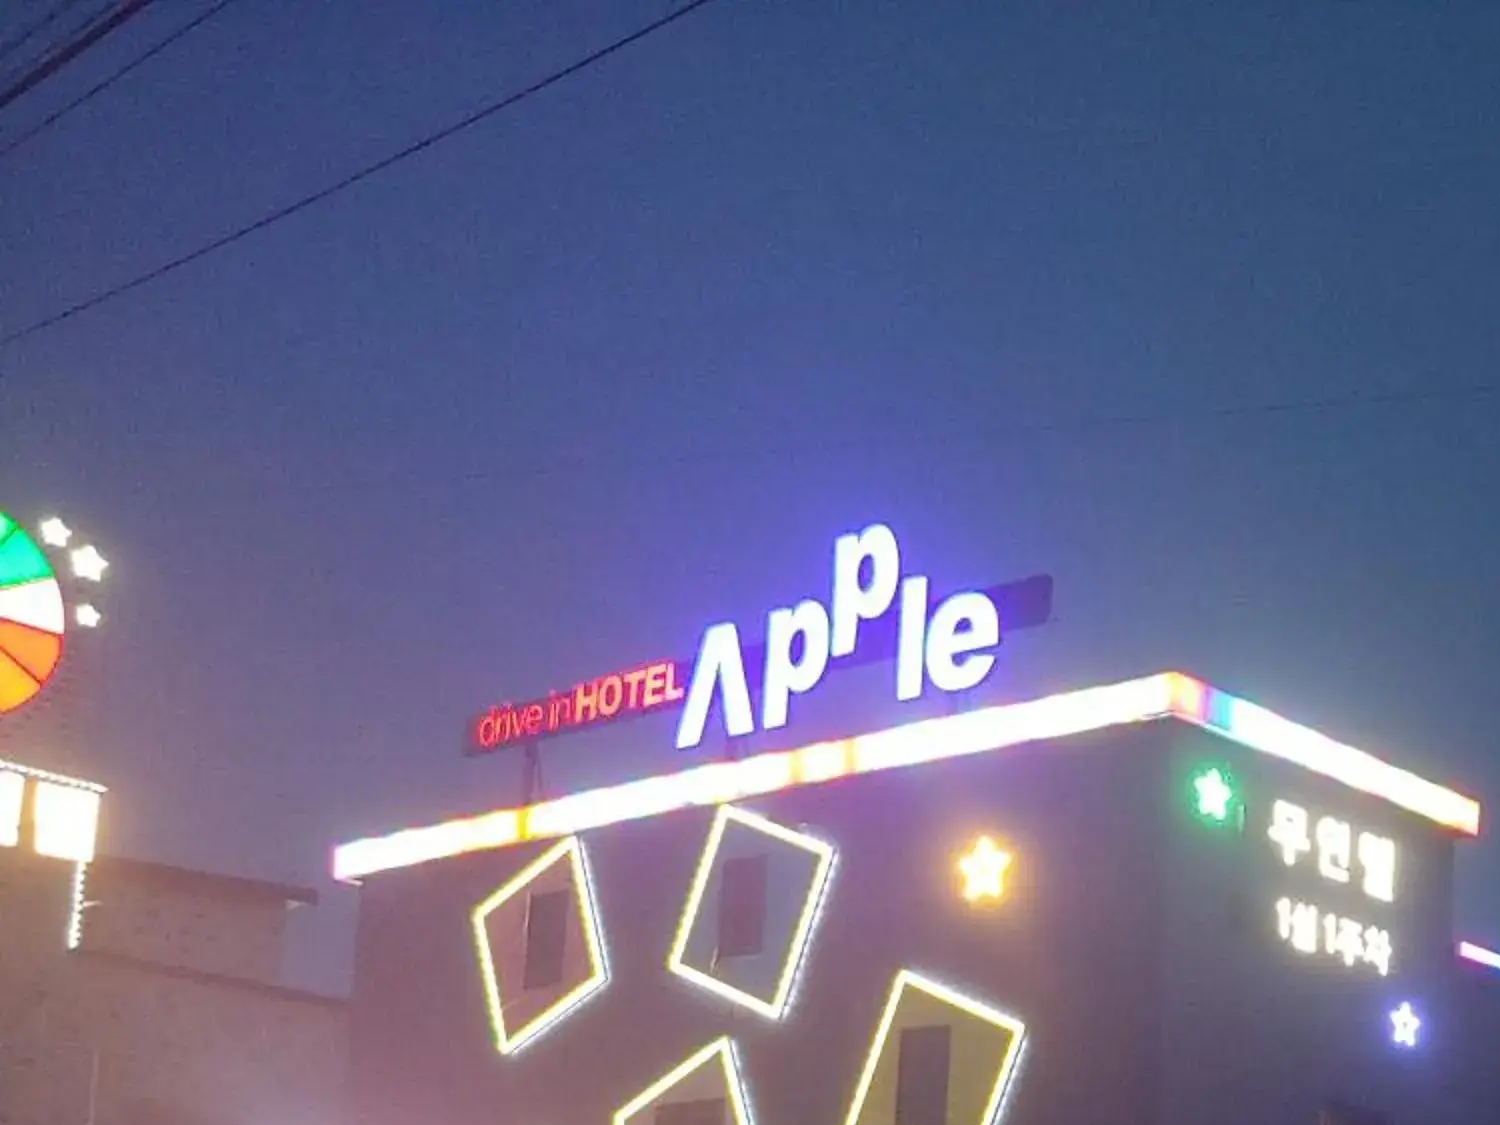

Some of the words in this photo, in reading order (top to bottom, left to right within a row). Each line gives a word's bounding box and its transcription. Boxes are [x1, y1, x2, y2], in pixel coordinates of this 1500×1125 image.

[480, 703, 544, 747] drive
[548, 691, 572, 731] in
[573, 662, 684, 719] HOTEL
[677, 523, 1000, 749] Apple
